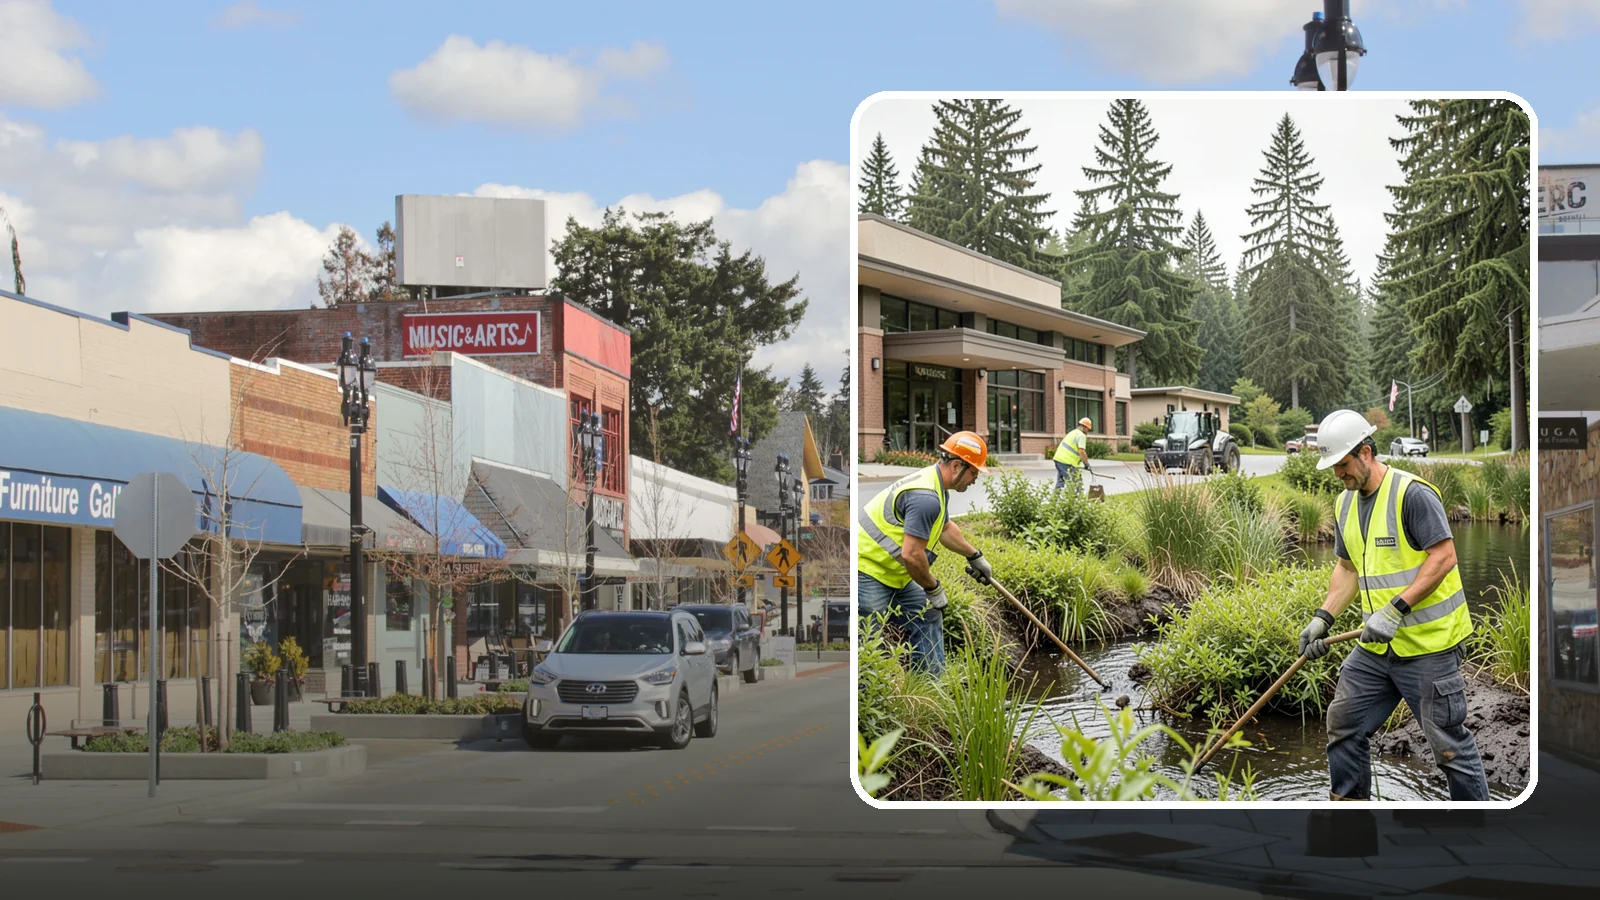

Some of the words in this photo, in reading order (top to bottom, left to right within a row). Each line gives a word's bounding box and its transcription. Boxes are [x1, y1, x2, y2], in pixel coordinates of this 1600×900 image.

[1540, 427, 1577, 437] UGA
[0, 471, 79, 515] Furniture
[89, 482, 121, 519] Gal
